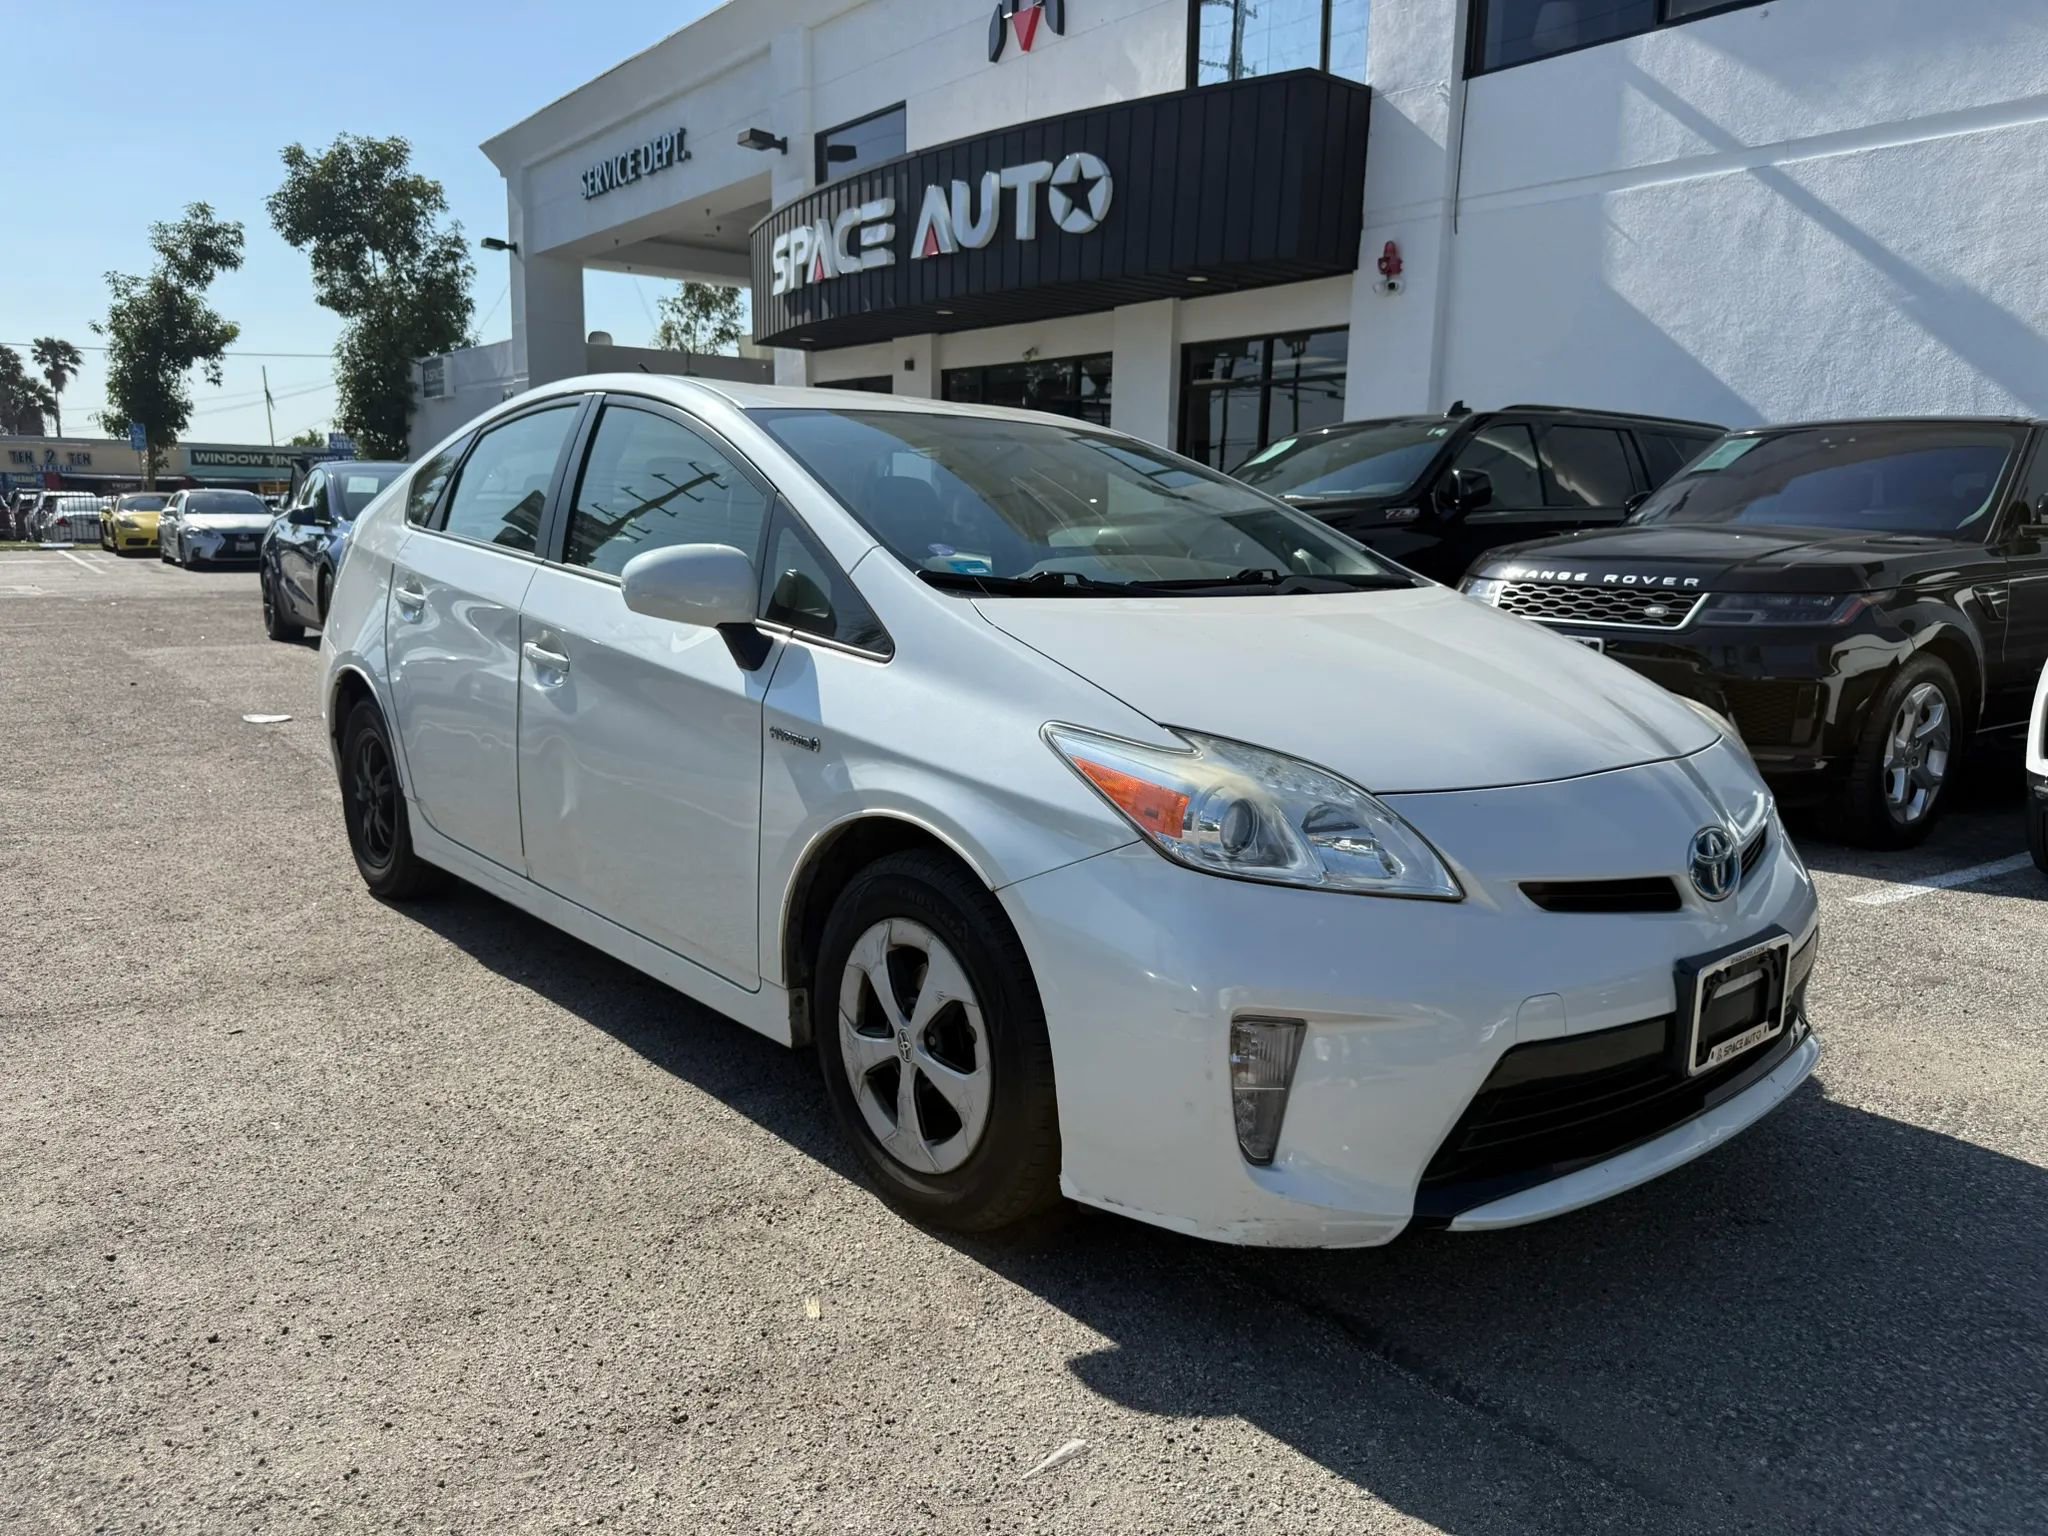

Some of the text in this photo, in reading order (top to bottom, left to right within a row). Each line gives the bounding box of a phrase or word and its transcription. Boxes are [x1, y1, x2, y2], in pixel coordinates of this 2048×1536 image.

[581, 128, 691, 200] SERVICE DEPT.
[773, 152, 1113, 296] SPACE AUTO
[45, 448, 55, 464] 2
[195, 452, 263, 465] WINDOW
[1505, 568, 1700, 587] ANGE ROVER
[1723, 1030, 1762, 1057] SPACE AUTO
